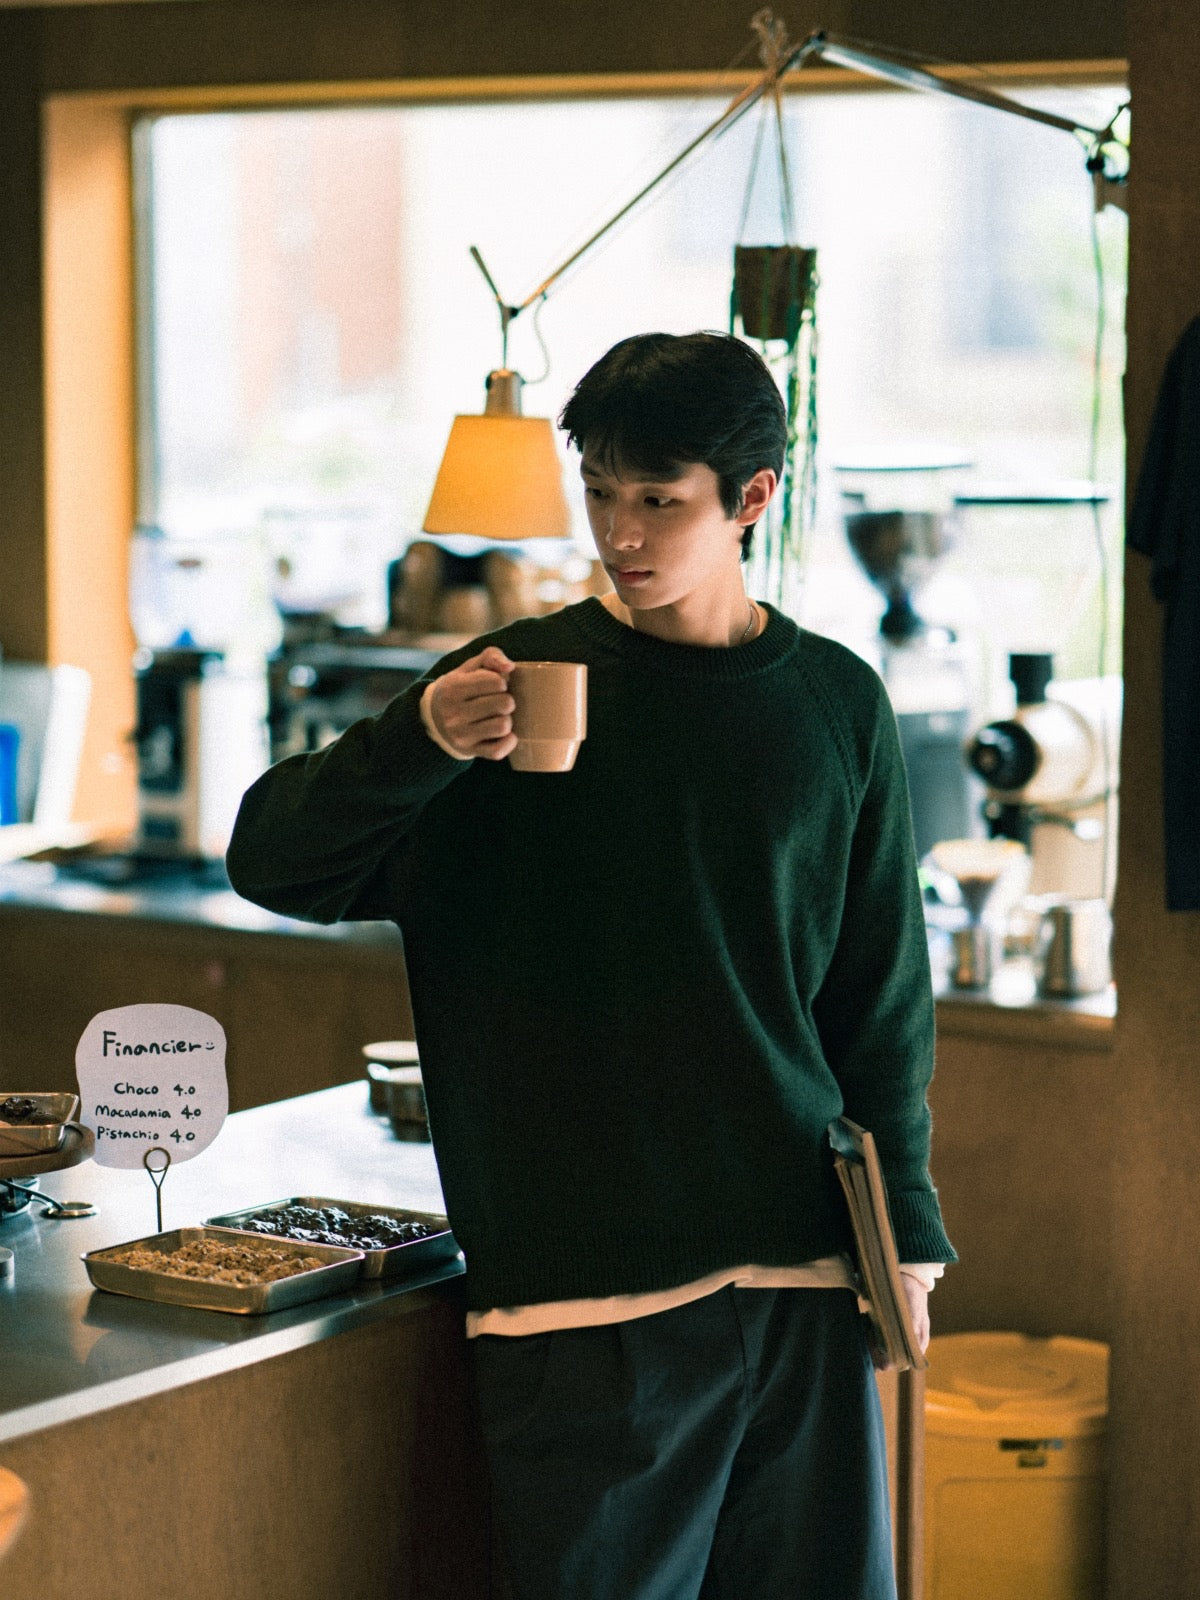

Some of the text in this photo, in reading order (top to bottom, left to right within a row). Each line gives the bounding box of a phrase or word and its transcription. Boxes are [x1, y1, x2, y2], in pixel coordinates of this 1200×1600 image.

[103, 1030, 201, 1057] Financier
[114, 1082, 196, 1096] Choco 4.0
[95, 1105, 201, 1120] Macadamia 4.0
[97, 1126, 196, 1143] Pistachio 4.0
